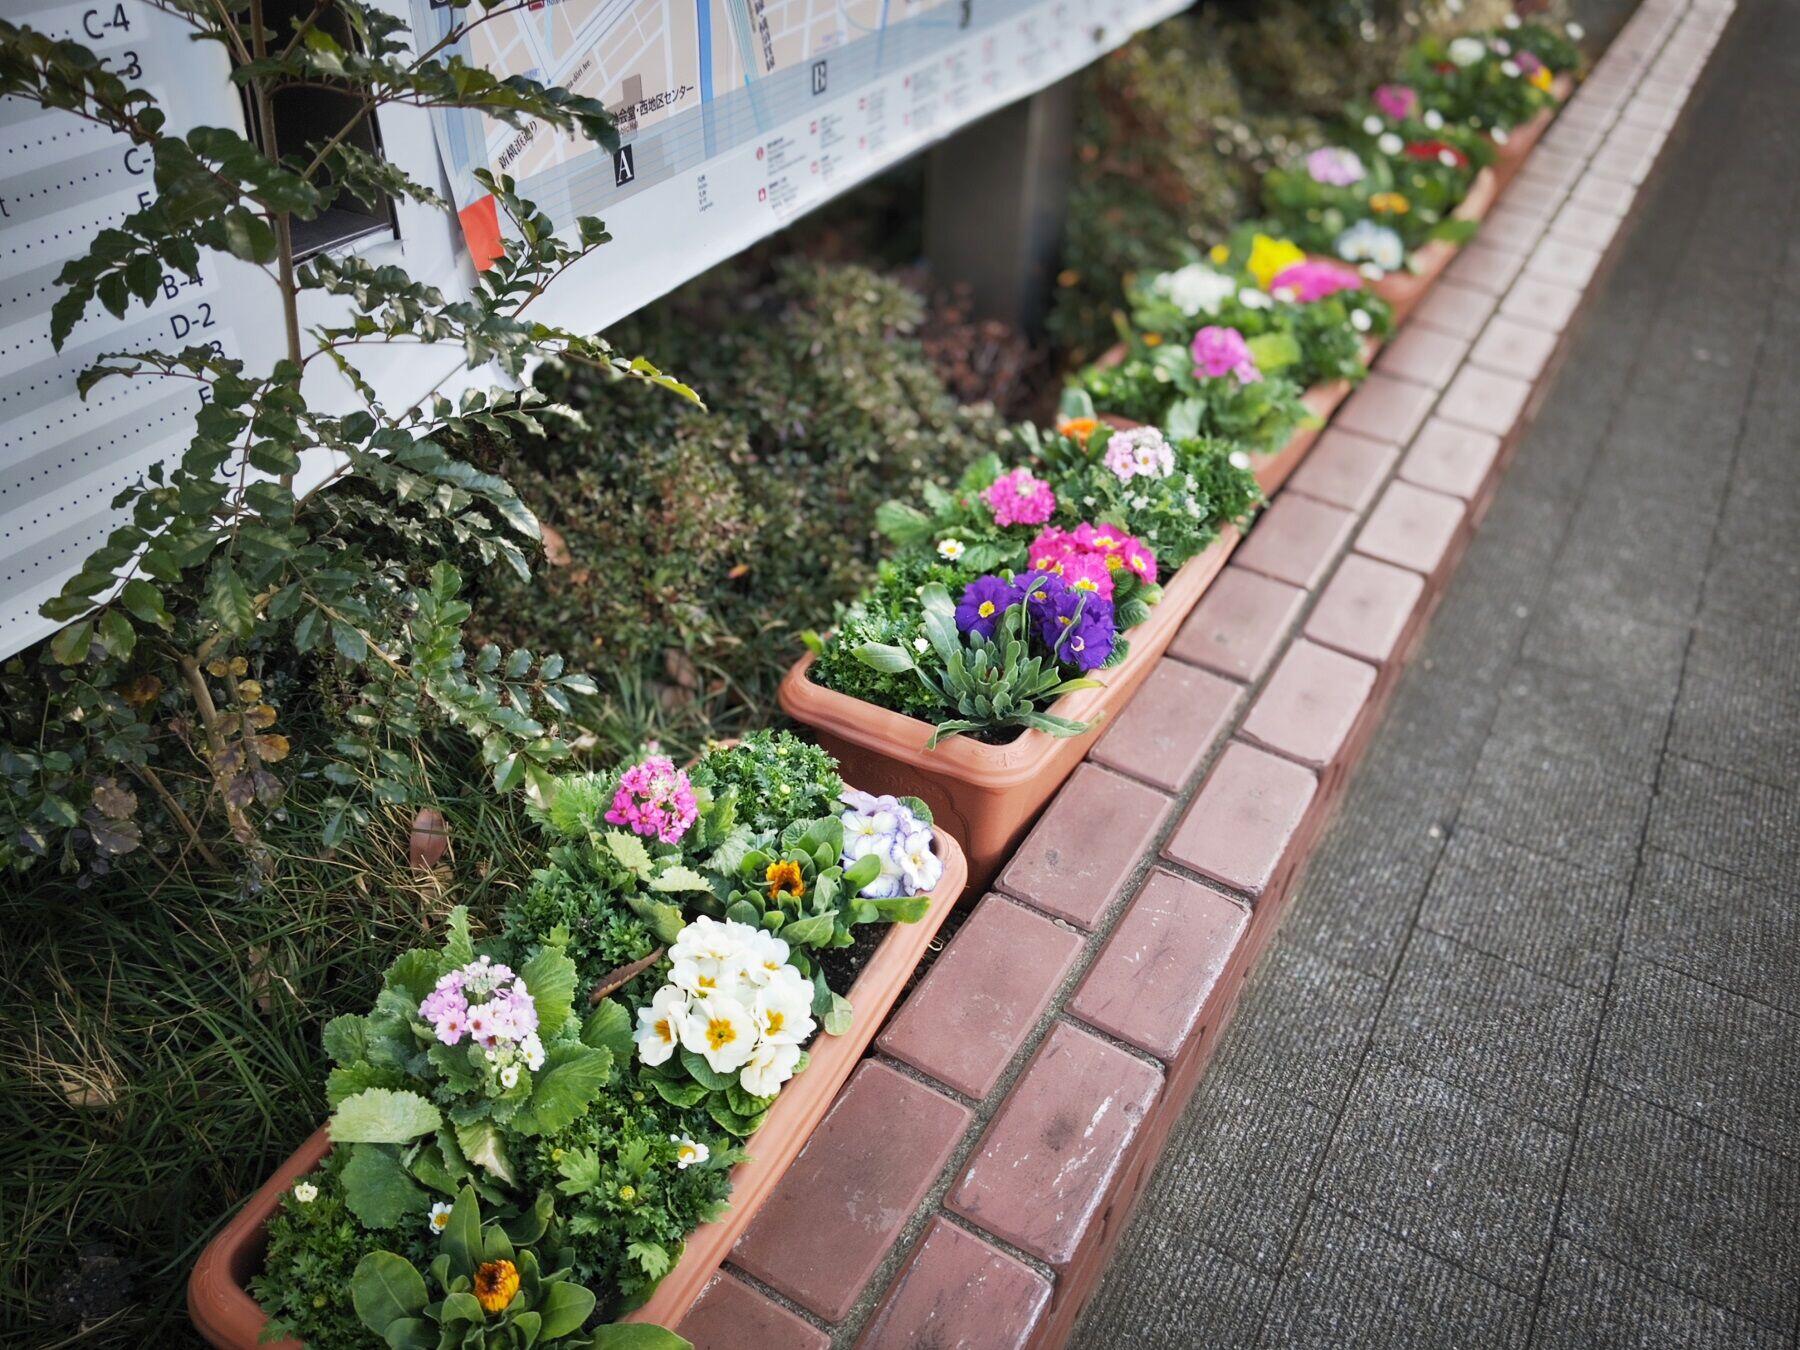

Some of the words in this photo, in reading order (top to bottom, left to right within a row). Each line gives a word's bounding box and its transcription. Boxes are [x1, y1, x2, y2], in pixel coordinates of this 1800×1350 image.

[83, 3, 130, 39] C-4
[616, 147, 634, 185] A
[162, 273, 204, 300] B-4
[170, 302, 216, 340] D-2
